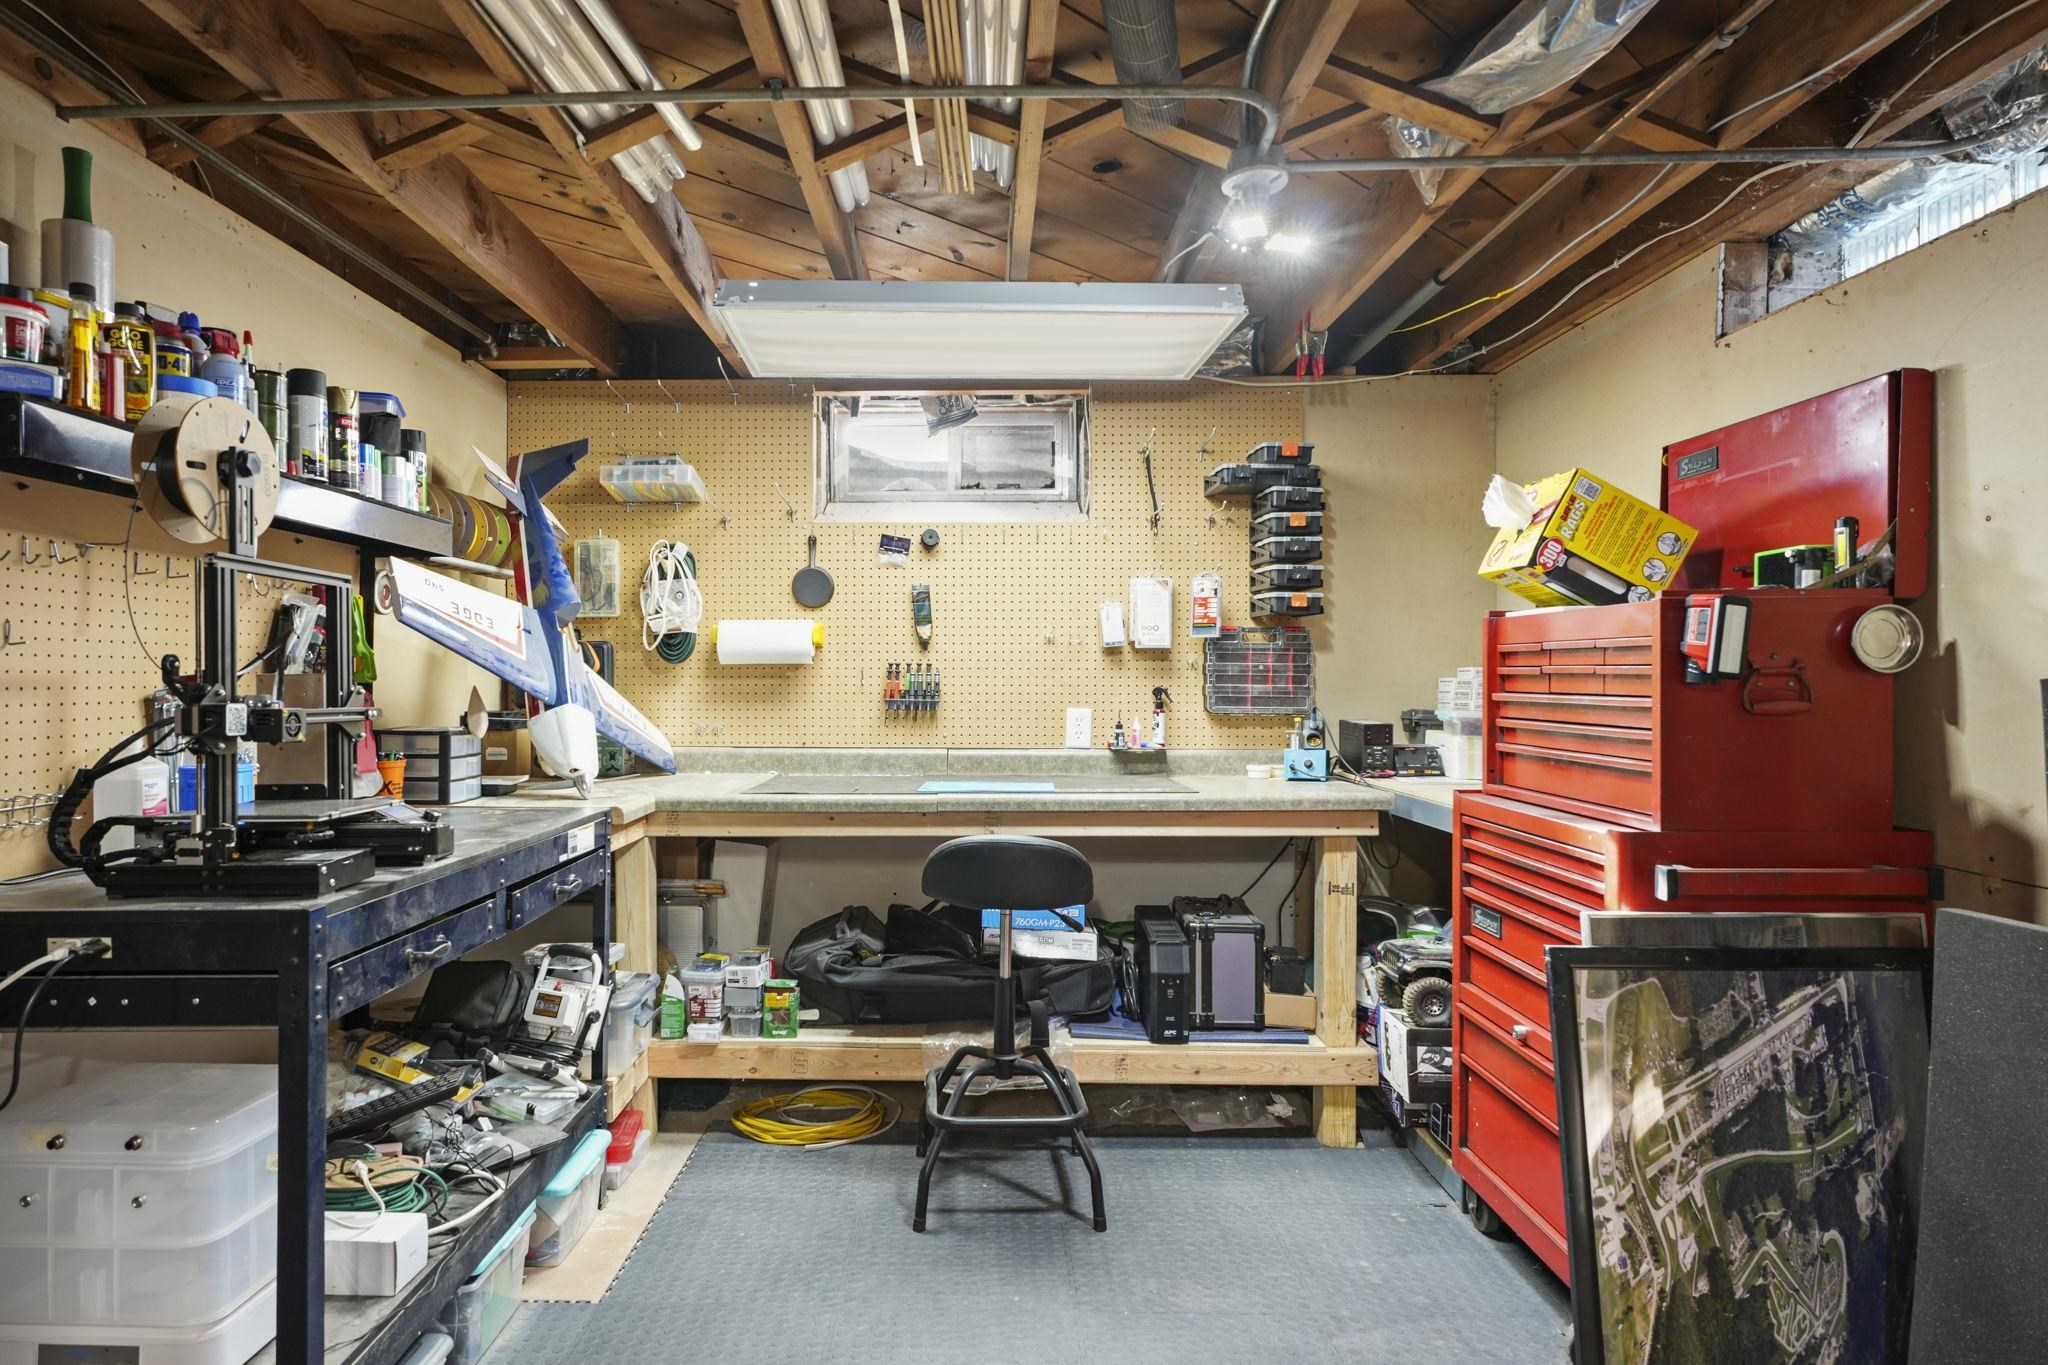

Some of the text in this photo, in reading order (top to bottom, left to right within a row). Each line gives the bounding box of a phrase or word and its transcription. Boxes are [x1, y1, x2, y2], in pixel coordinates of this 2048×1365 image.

[1559, 498, 1586, 539] RAGS
[1538, 539, 1563, 568] 300
[451, 601, 494, 629] EDGE
